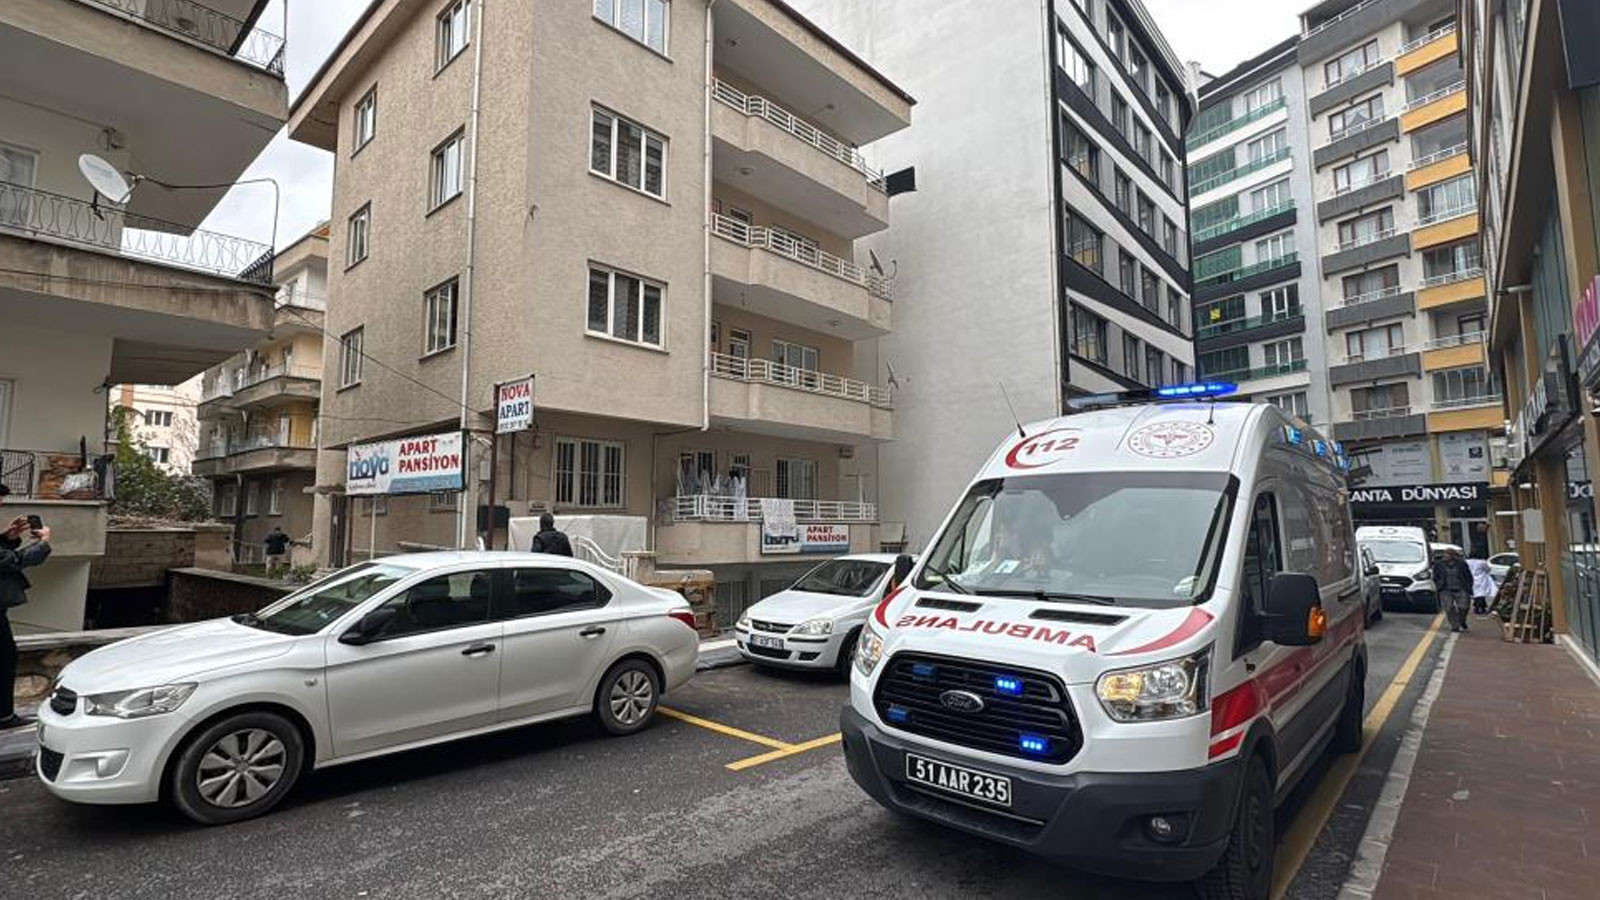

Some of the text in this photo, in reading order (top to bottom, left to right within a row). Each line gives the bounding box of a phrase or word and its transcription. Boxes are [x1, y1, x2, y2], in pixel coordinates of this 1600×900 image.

[501, 383, 529, 402] NOVA
[500, 401, 529, 419] APART
[398, 440, 438, 456] APART
[1023, 437, 1080, 455] 112
[398, 455, 460, 472] PANSİYON
[1401, 484, 1478, 501] DÜNYASI
[807, 526, 834, 534] APART
[916, 760, 1008, 801] 51 AAR 235
